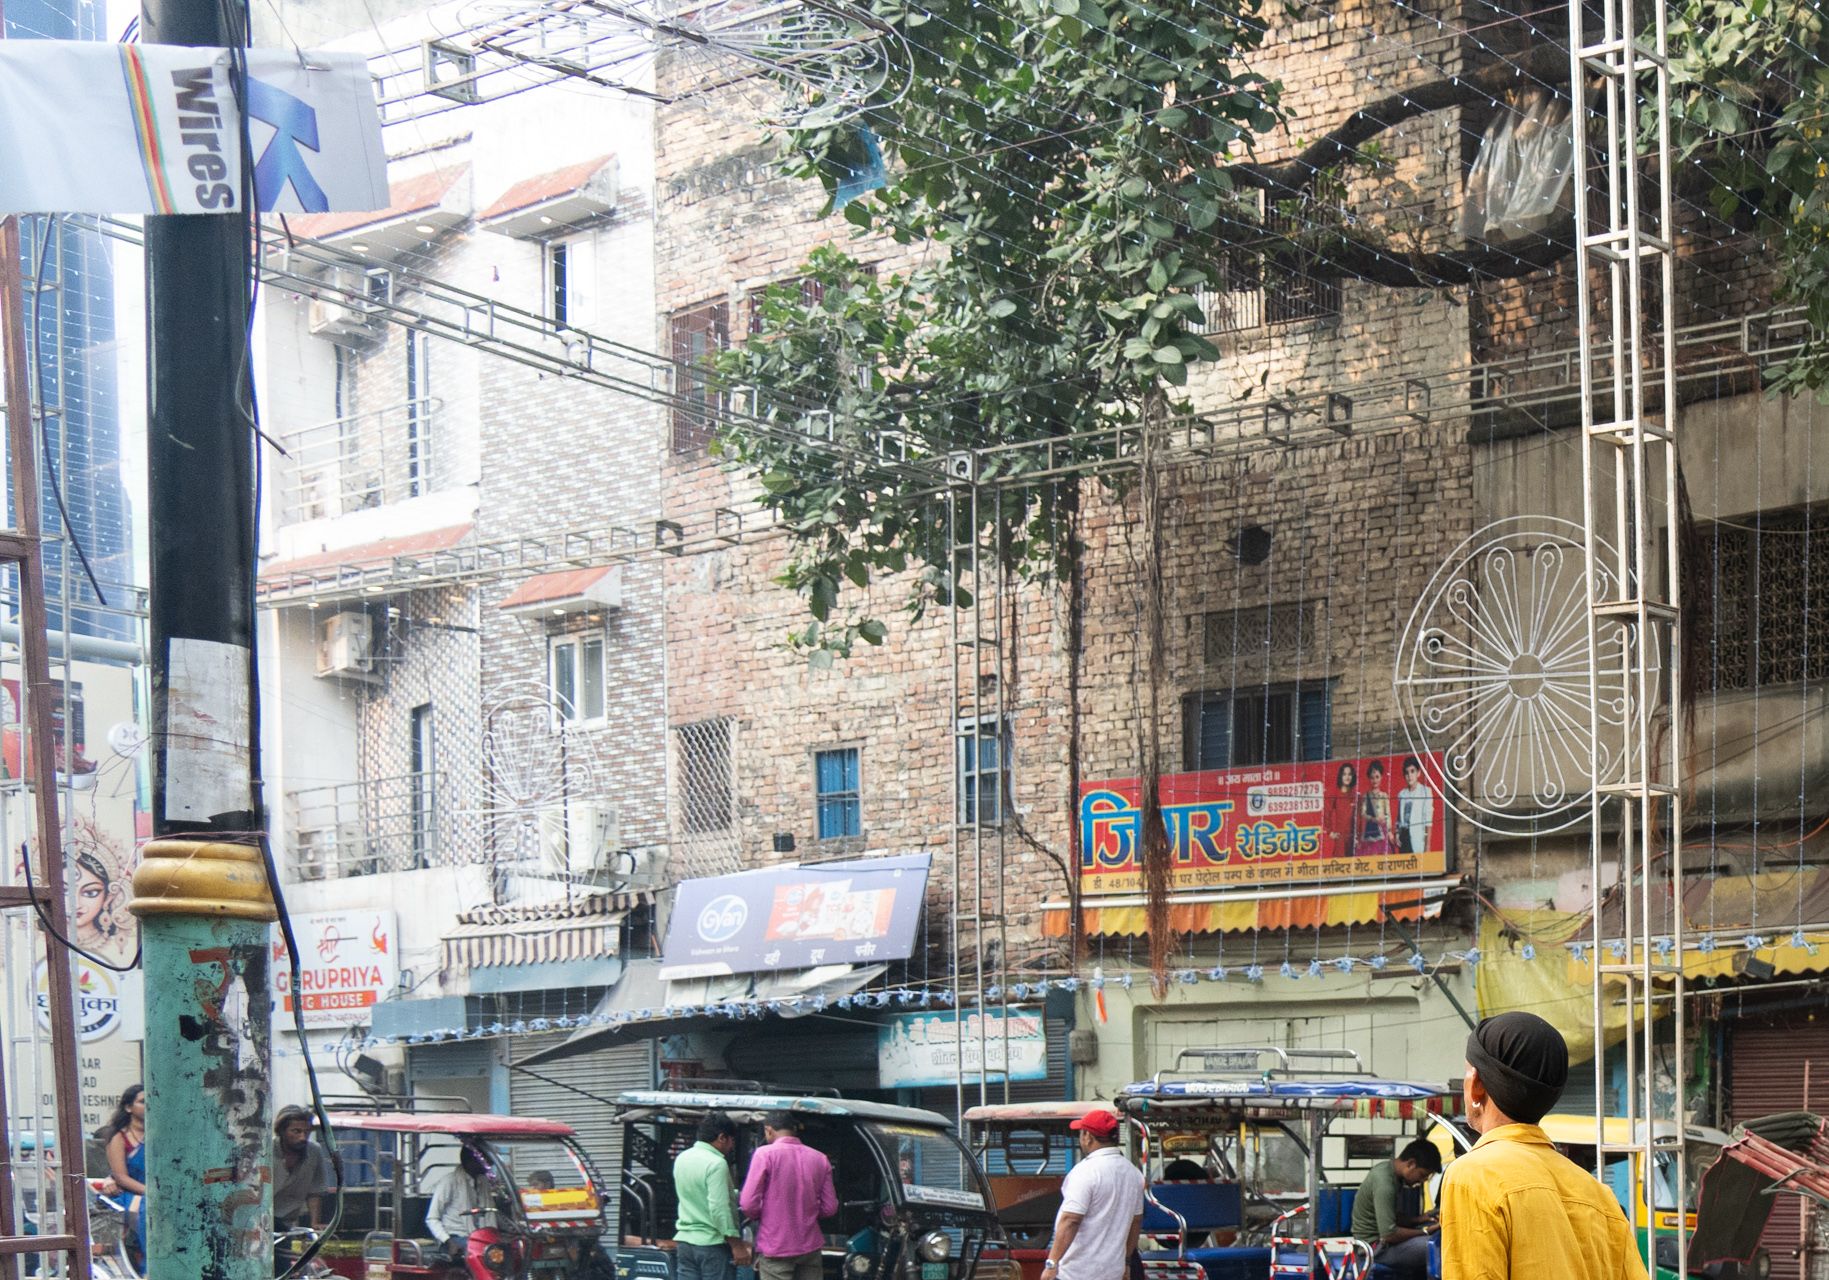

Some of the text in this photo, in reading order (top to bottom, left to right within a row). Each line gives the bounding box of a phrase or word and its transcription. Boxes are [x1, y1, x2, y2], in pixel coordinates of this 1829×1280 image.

[1297, 863, 1319, 876] गीता
[1377, 855, 1418, 871] वराणसी
[275, 965, 384, 992] GRUPRIYA
[321, 993, 364, 1008] HOUSE
